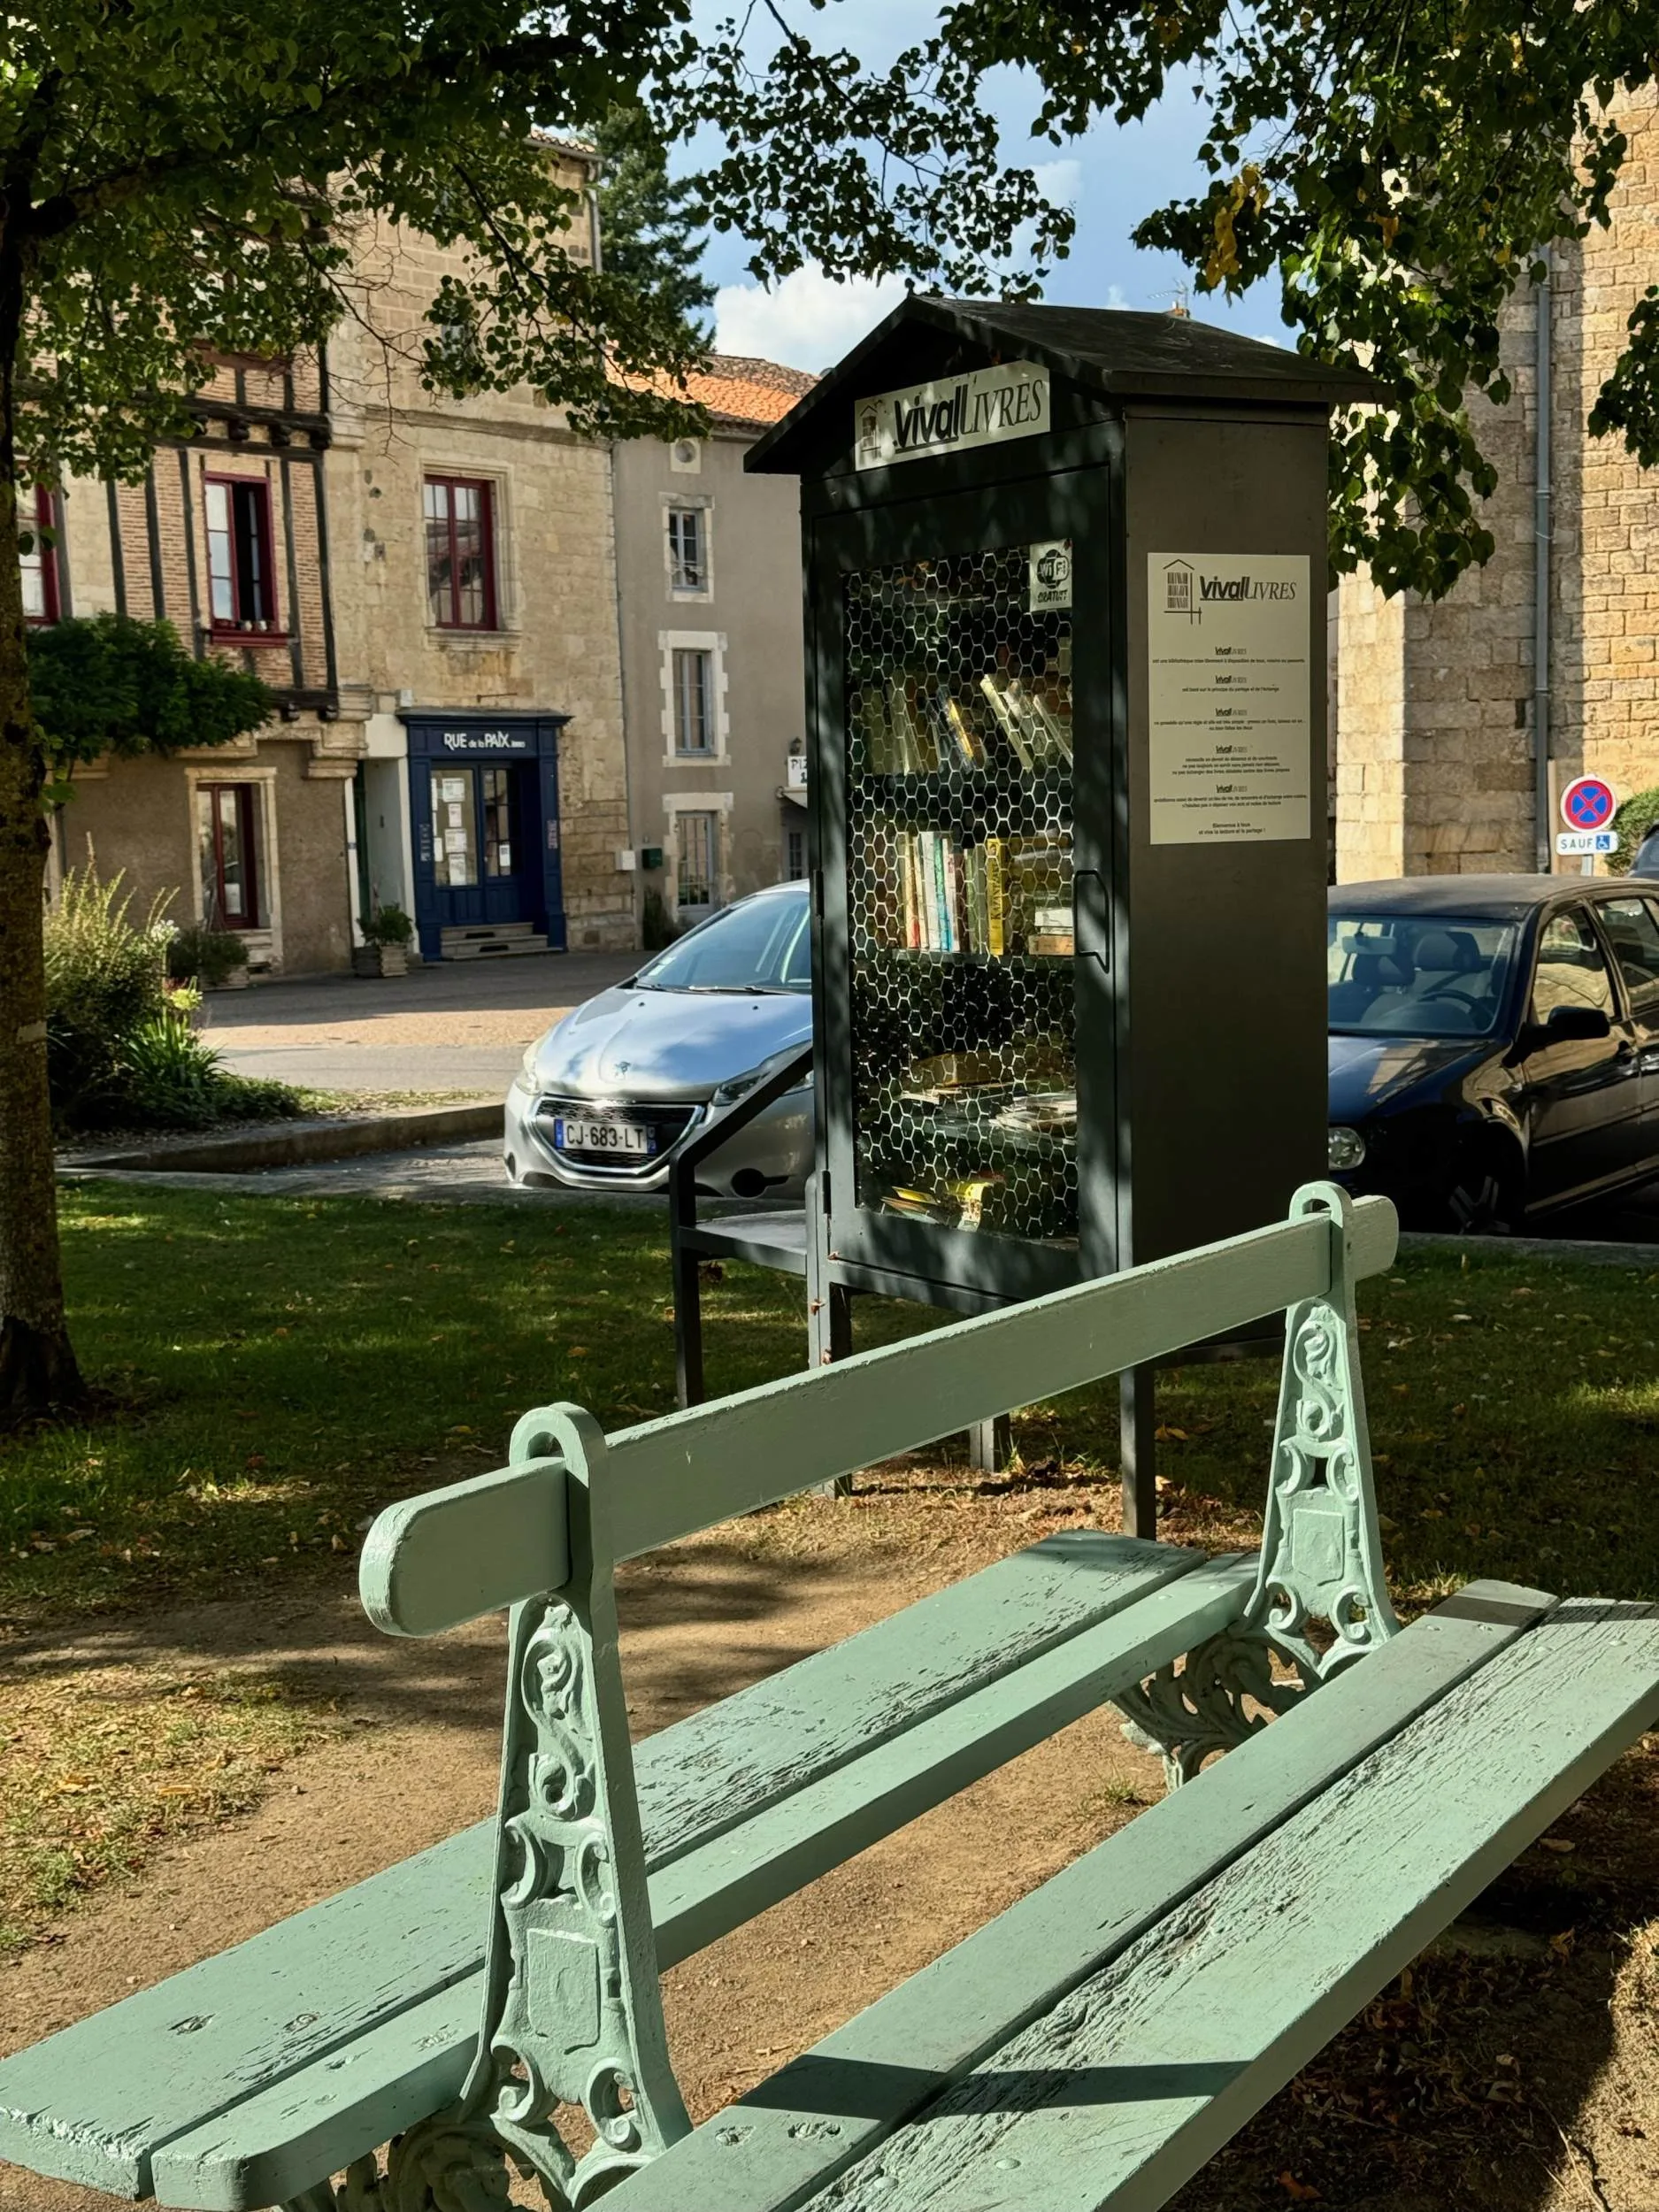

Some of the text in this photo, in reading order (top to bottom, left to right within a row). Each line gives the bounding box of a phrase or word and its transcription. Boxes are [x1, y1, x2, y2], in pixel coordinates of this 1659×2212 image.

[444, 733, 467, 750] RUE
[484, 731, 511, 748] PAIX
[1560, 838, 1593, 849] SAUF
[567, 1125, 643, 1148] CJ-683-LT
